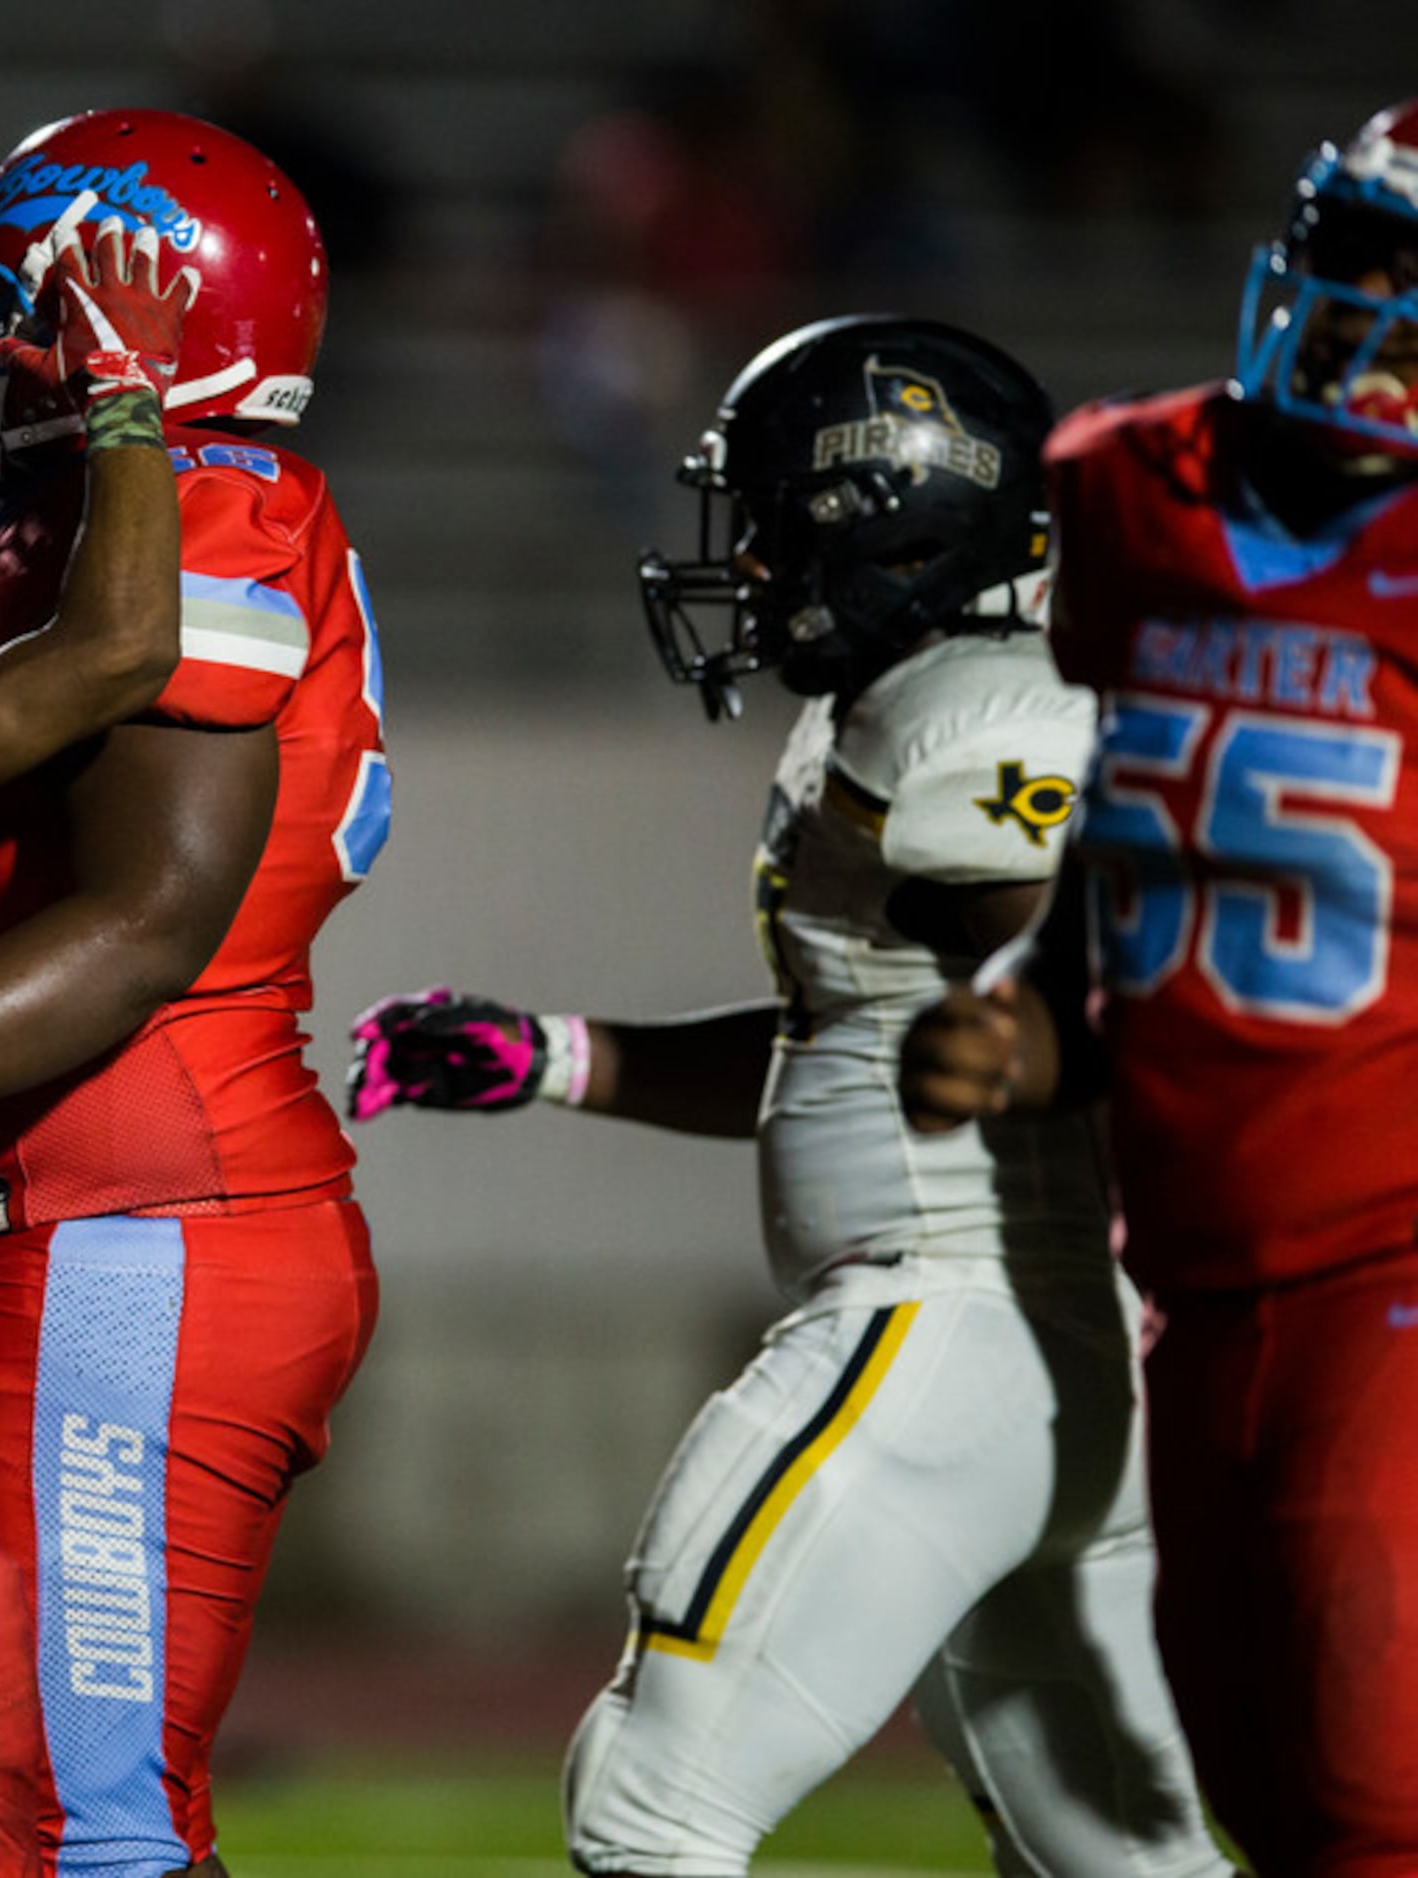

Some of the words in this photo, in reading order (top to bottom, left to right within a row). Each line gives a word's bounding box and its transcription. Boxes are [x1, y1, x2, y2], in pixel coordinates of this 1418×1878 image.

[813, 414, 1002, 490] PIRTES
[1087, 694, 1403, 1029] 55
[60, 1413, 154, 1703] COWBOYS
